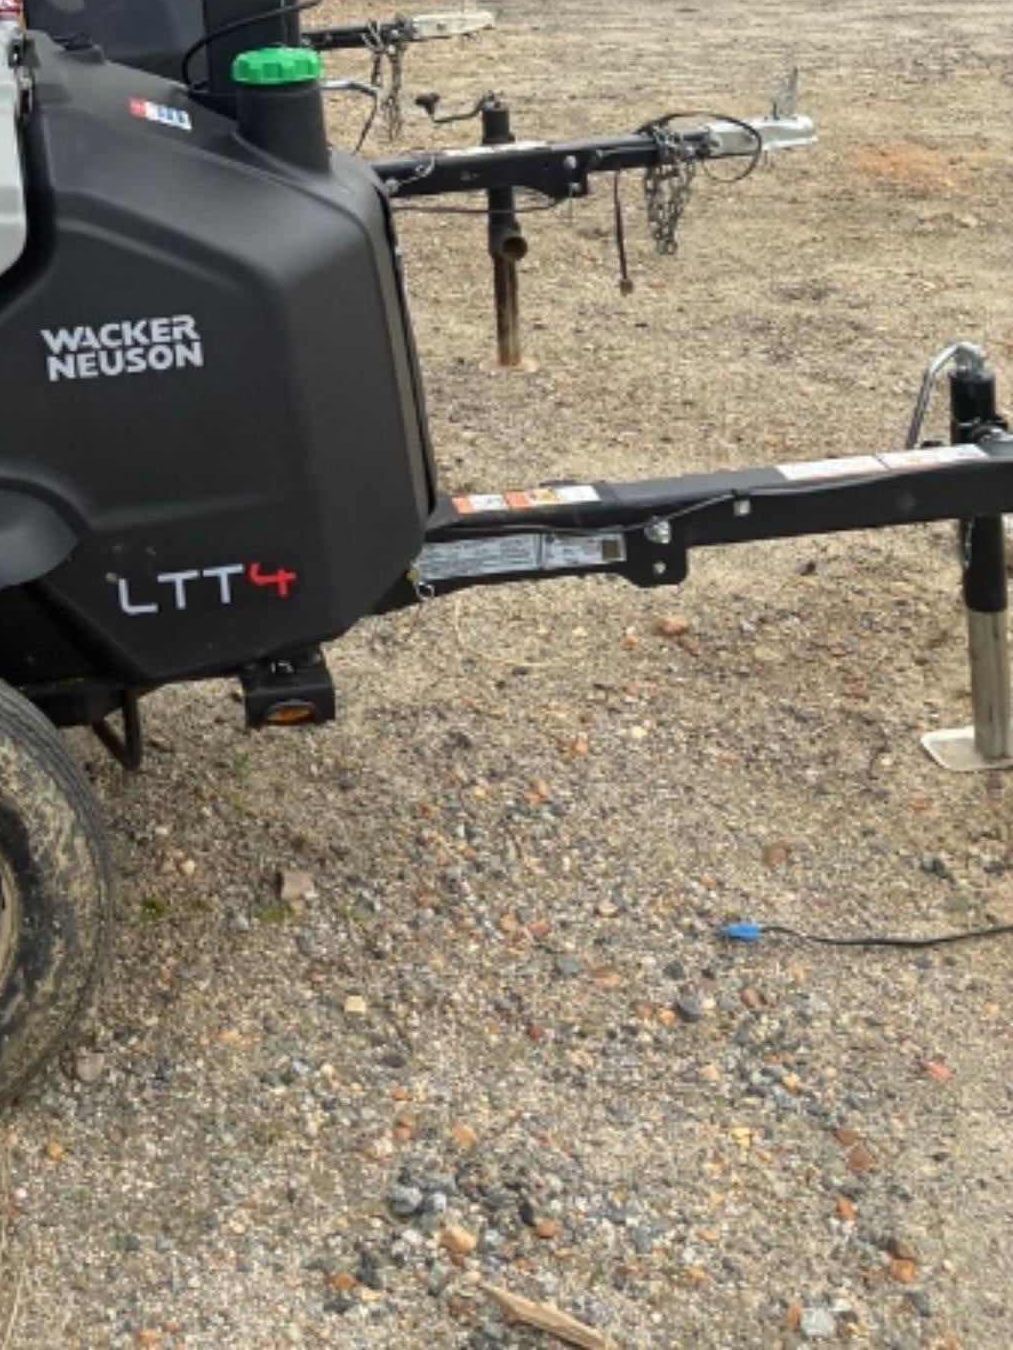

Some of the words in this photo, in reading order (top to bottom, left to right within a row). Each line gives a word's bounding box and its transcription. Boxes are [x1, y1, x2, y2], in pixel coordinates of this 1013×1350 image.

[40, 314, 201, 355] WACKER
[46, 341, 204, 382] NEUSON
[117, 562, 297, 615] LTT4
